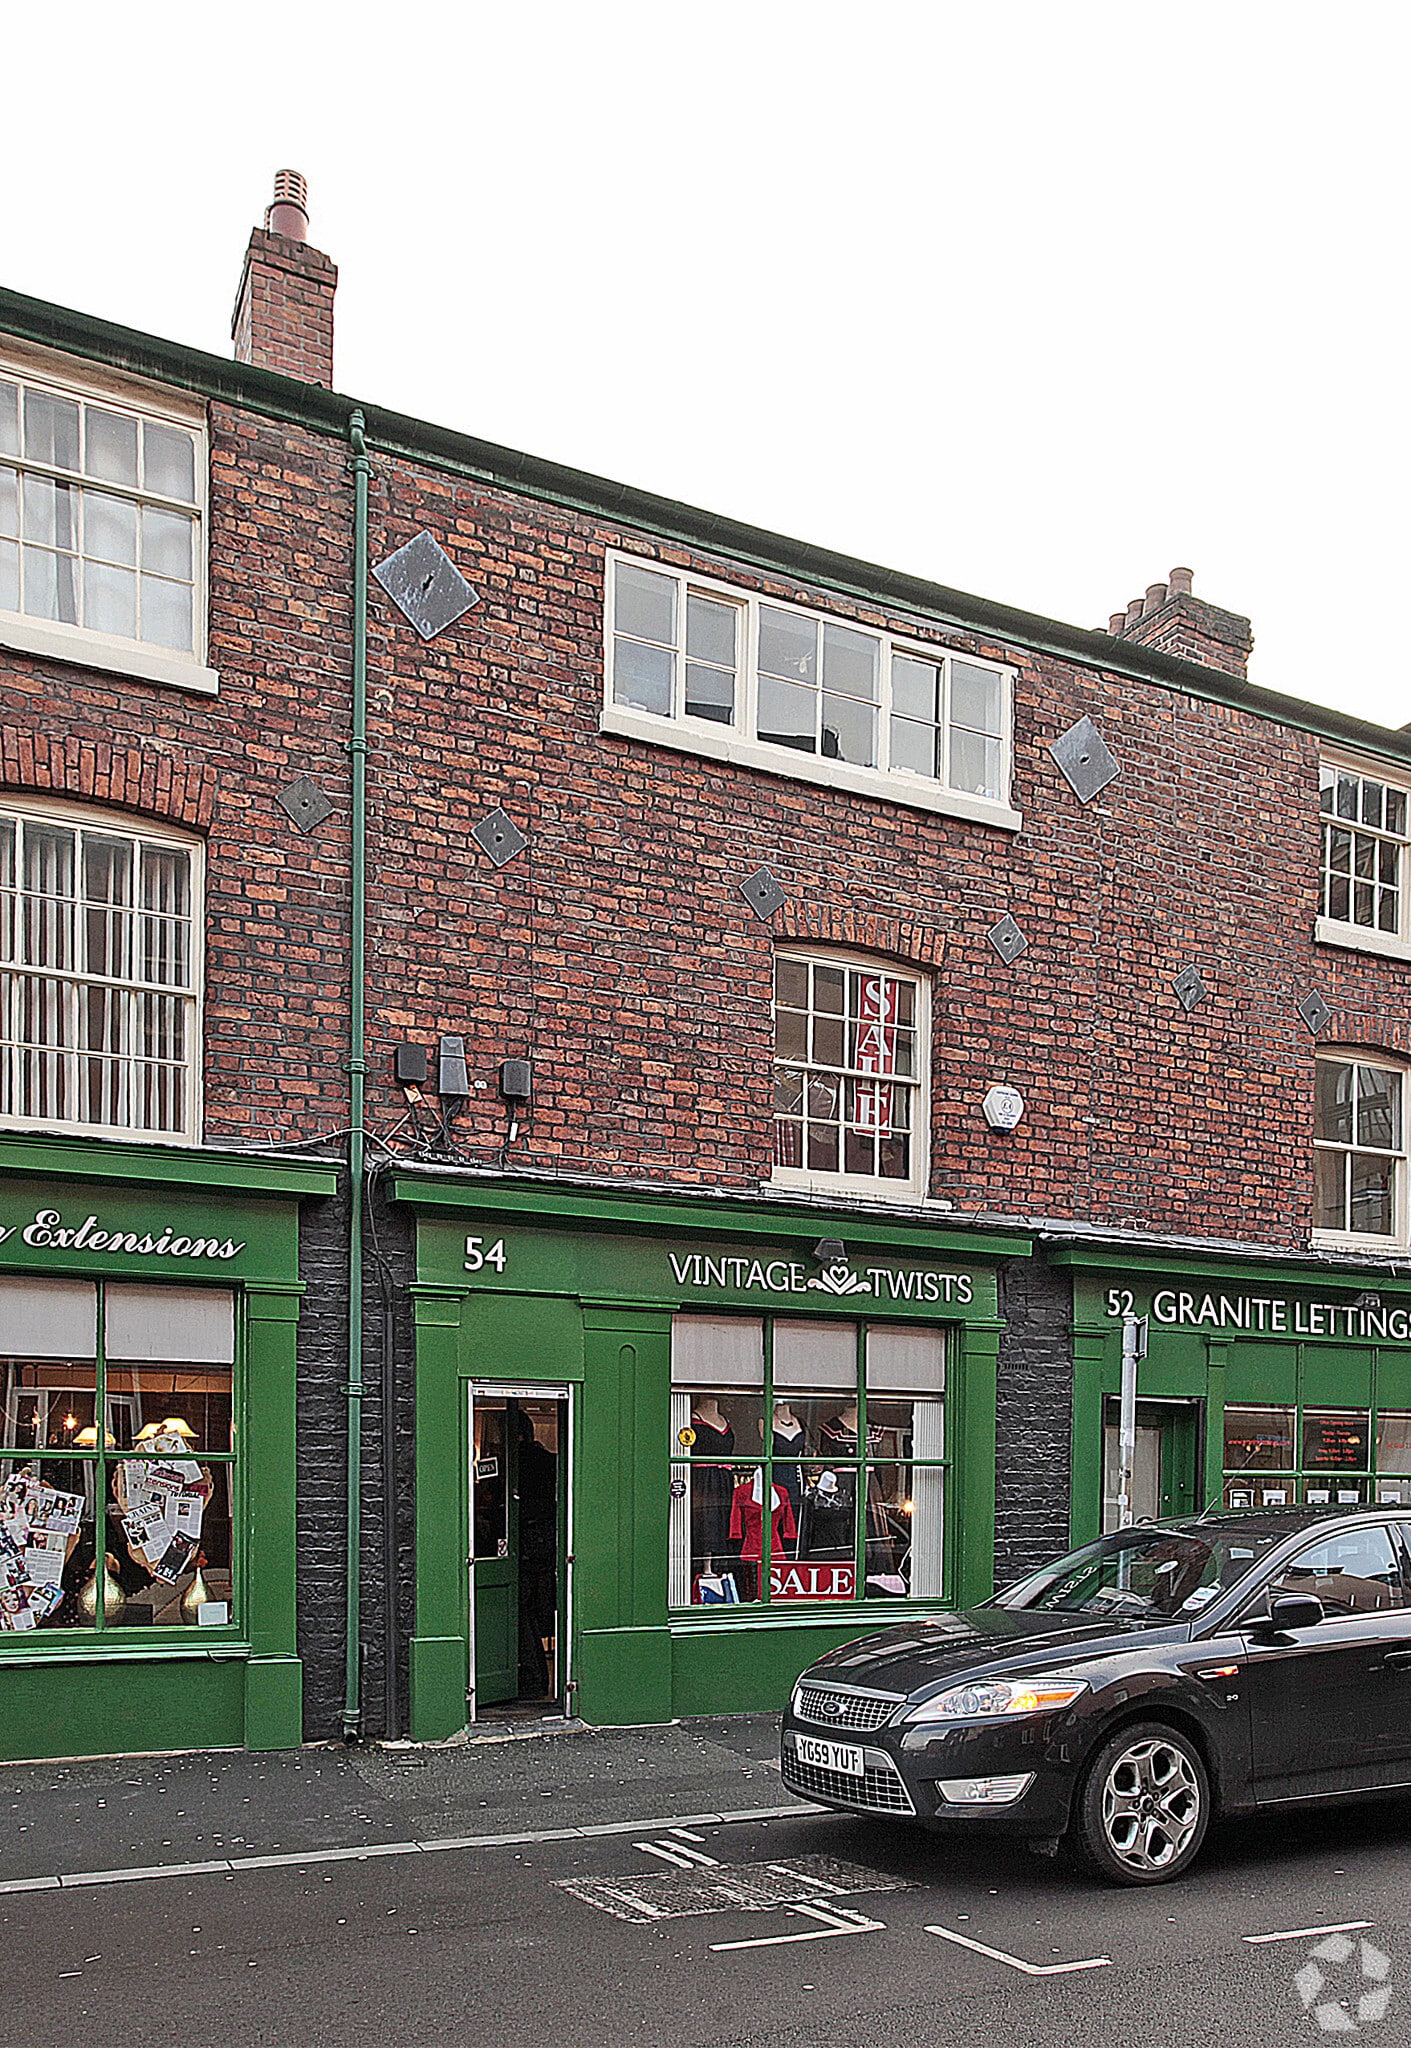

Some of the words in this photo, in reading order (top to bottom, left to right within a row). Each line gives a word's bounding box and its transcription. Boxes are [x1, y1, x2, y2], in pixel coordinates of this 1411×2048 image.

[856, 980, 892, 1127] SALE
[22, 1208, 246, 1259] Extensions
[464, 1236, 507, 1272] 54
[669, 1253, 807, 1292] VINTAGE
[866, 1268, 973, 1303] TWISTS
[1107, 1289, 1136, 1317] 52
[1153, 1291, 1286, 1331] GRANITE
[1295, 1301, 1411, 1340] LETTING
[770, 1567, 853, 1595] SALE
[801, 1739, 829, 1765] YG59
[832, 1746, 858, 1771] YUT
